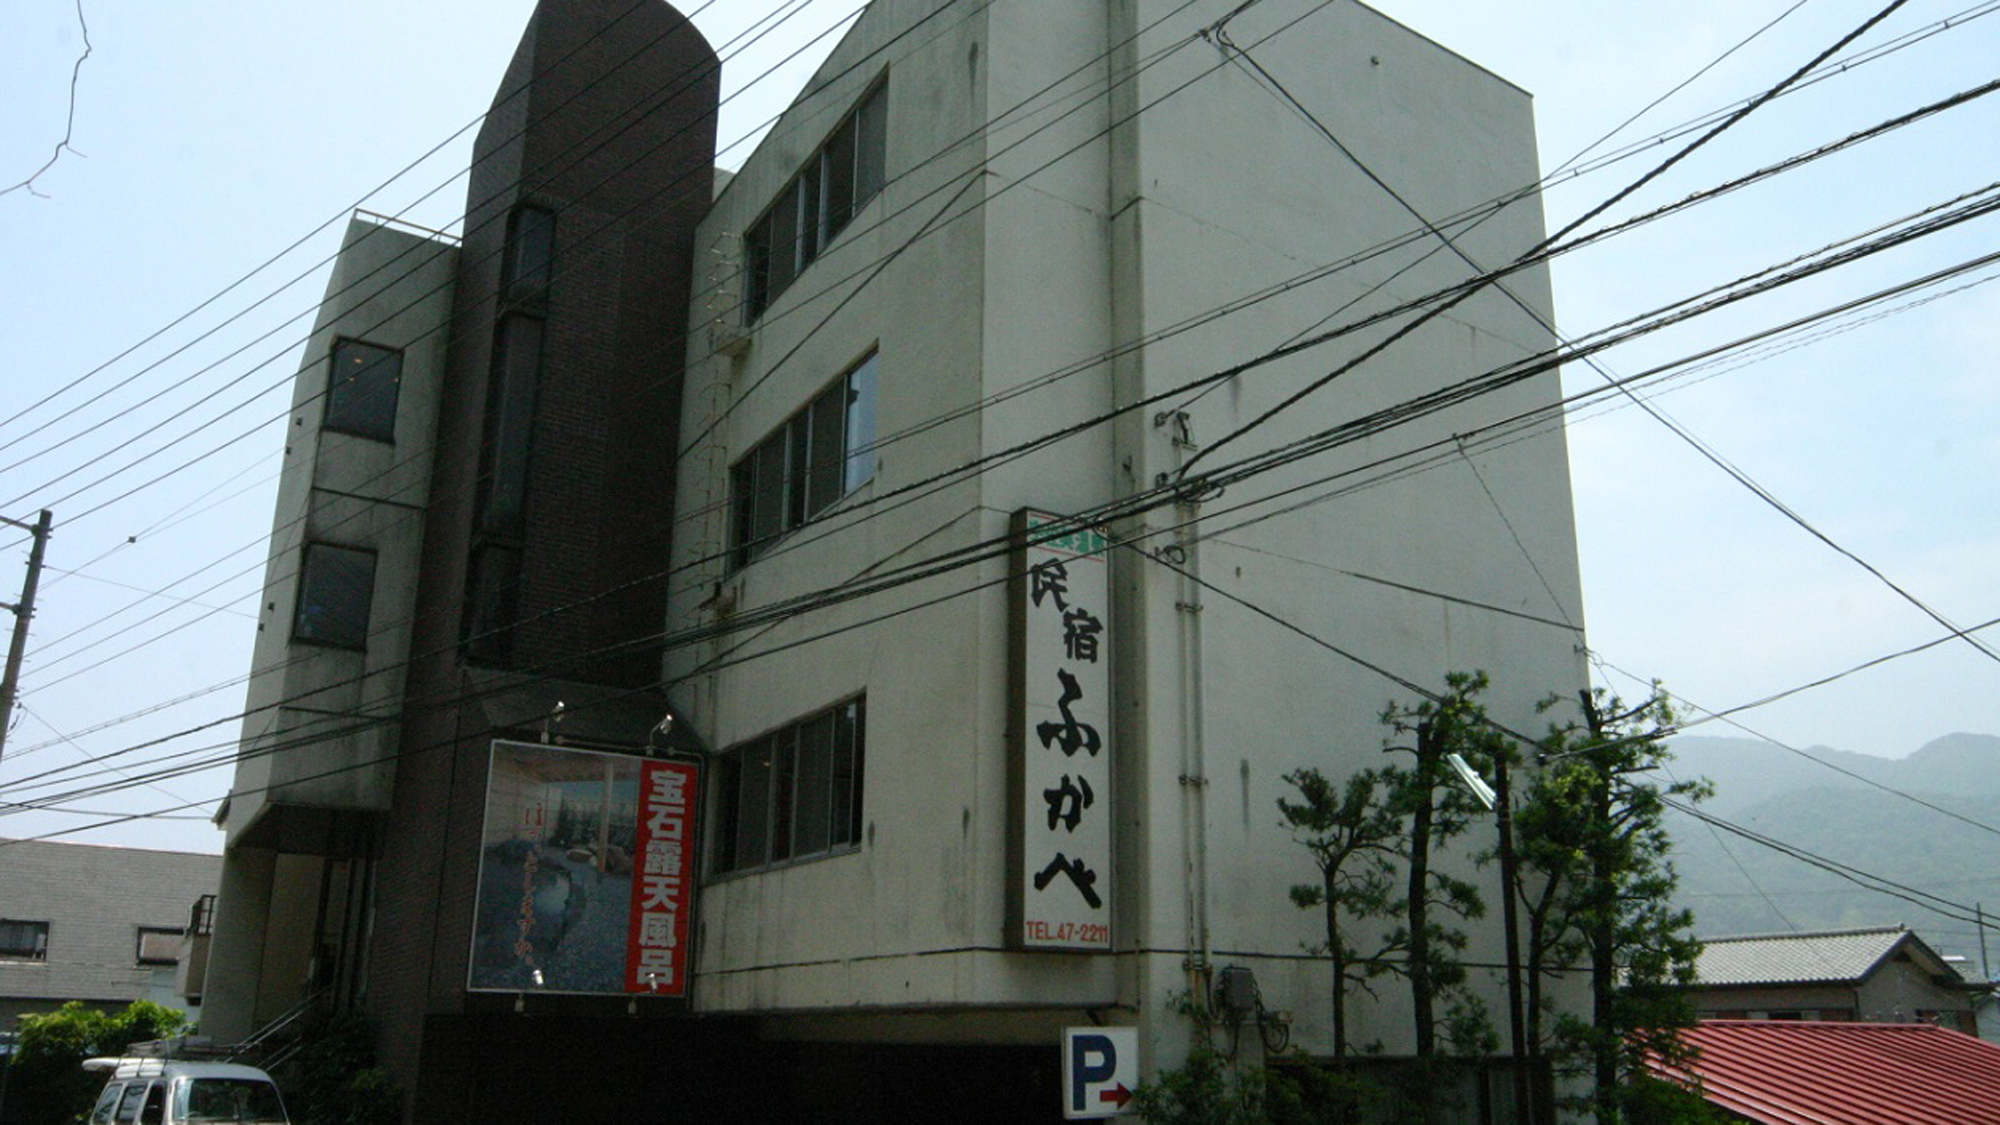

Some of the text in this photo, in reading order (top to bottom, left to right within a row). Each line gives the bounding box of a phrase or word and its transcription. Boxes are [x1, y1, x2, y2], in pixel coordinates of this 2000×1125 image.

[636, 769, 687, 986] 宝石露天風呂
[1072, 1034, 1117, 1111] P
